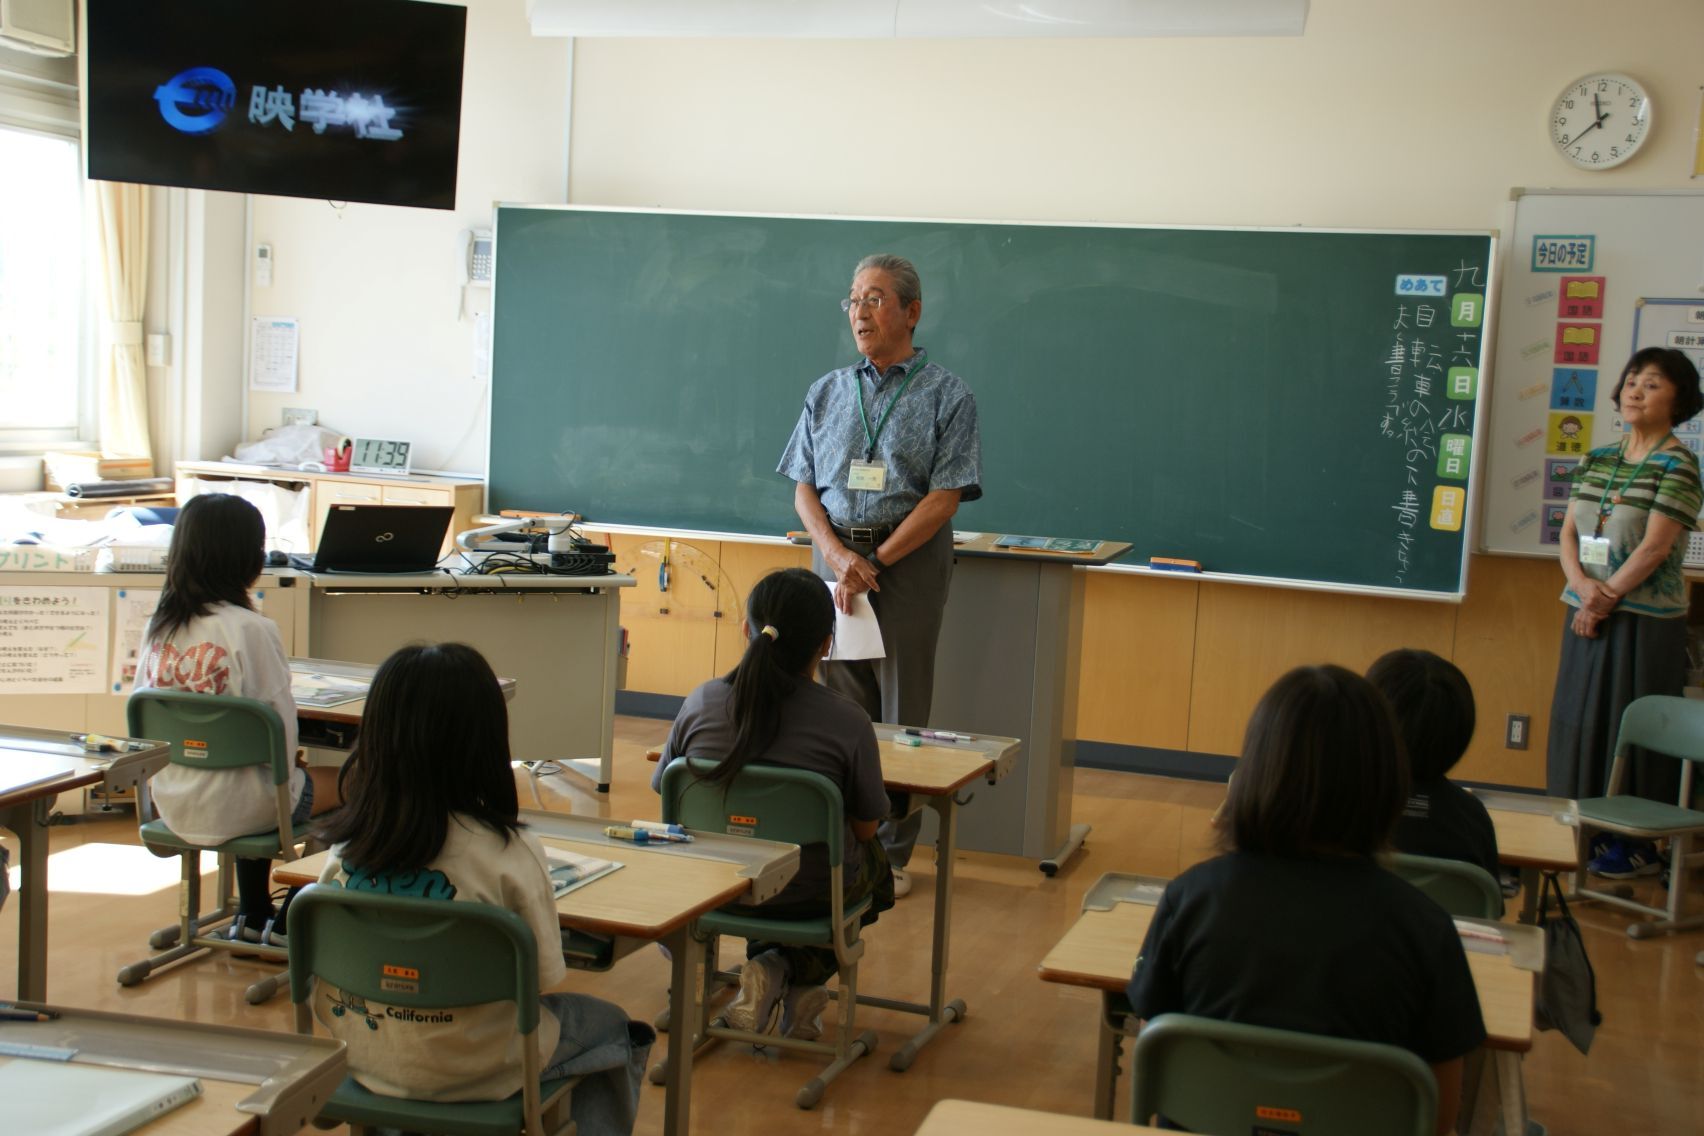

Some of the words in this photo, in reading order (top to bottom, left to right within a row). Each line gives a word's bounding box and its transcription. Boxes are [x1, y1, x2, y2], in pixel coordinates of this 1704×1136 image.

[1580, 87, 1587, 96] 11
[1598, 82, 1608, 92] 12
[1565, 100, 1574, 109] 10
[1629, 97, 1637, 108] 2
[248, 85, 404, 141] 映学社
[1559, 117, 1567, 126] 9
[1632, 116, 1640, 126] 3
[1561, 134, 1569, 144] 8
[1625, 134, 1633, 142] 4
[1575, 146, 1582, 156] 7
[1610, 146, 1617, 157] 5
[1591, 152, 1599, 161] 6
[1538, 242, 1587, 265] 今日の予定
[1400, 278, 1444, 292] めあて
[362, 441, 411, 466] 11:39
[386, 1006, 454, 1024] California
